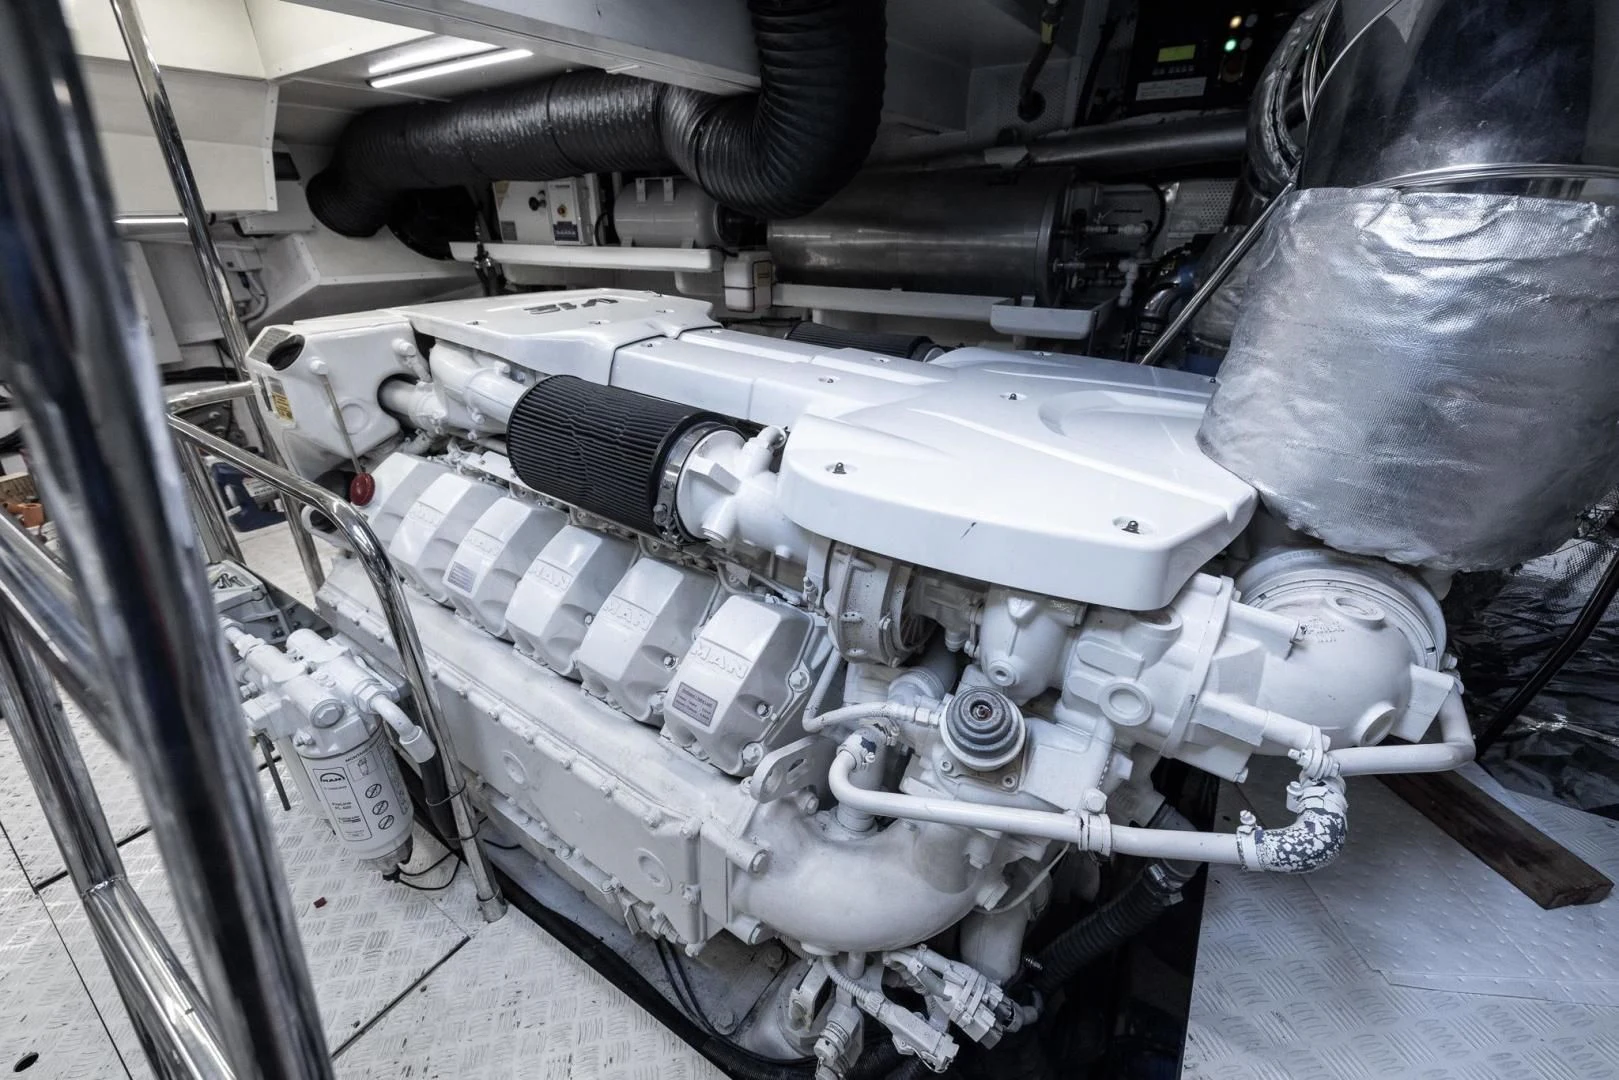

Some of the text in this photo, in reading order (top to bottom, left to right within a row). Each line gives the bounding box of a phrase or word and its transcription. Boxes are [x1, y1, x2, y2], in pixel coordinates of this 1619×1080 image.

[523, 298, 618, 314] V12
[528, 563, 571, 591] MAN
[602, 598, 652, 632] MAN
[690, 641, 749, 679] MAN
